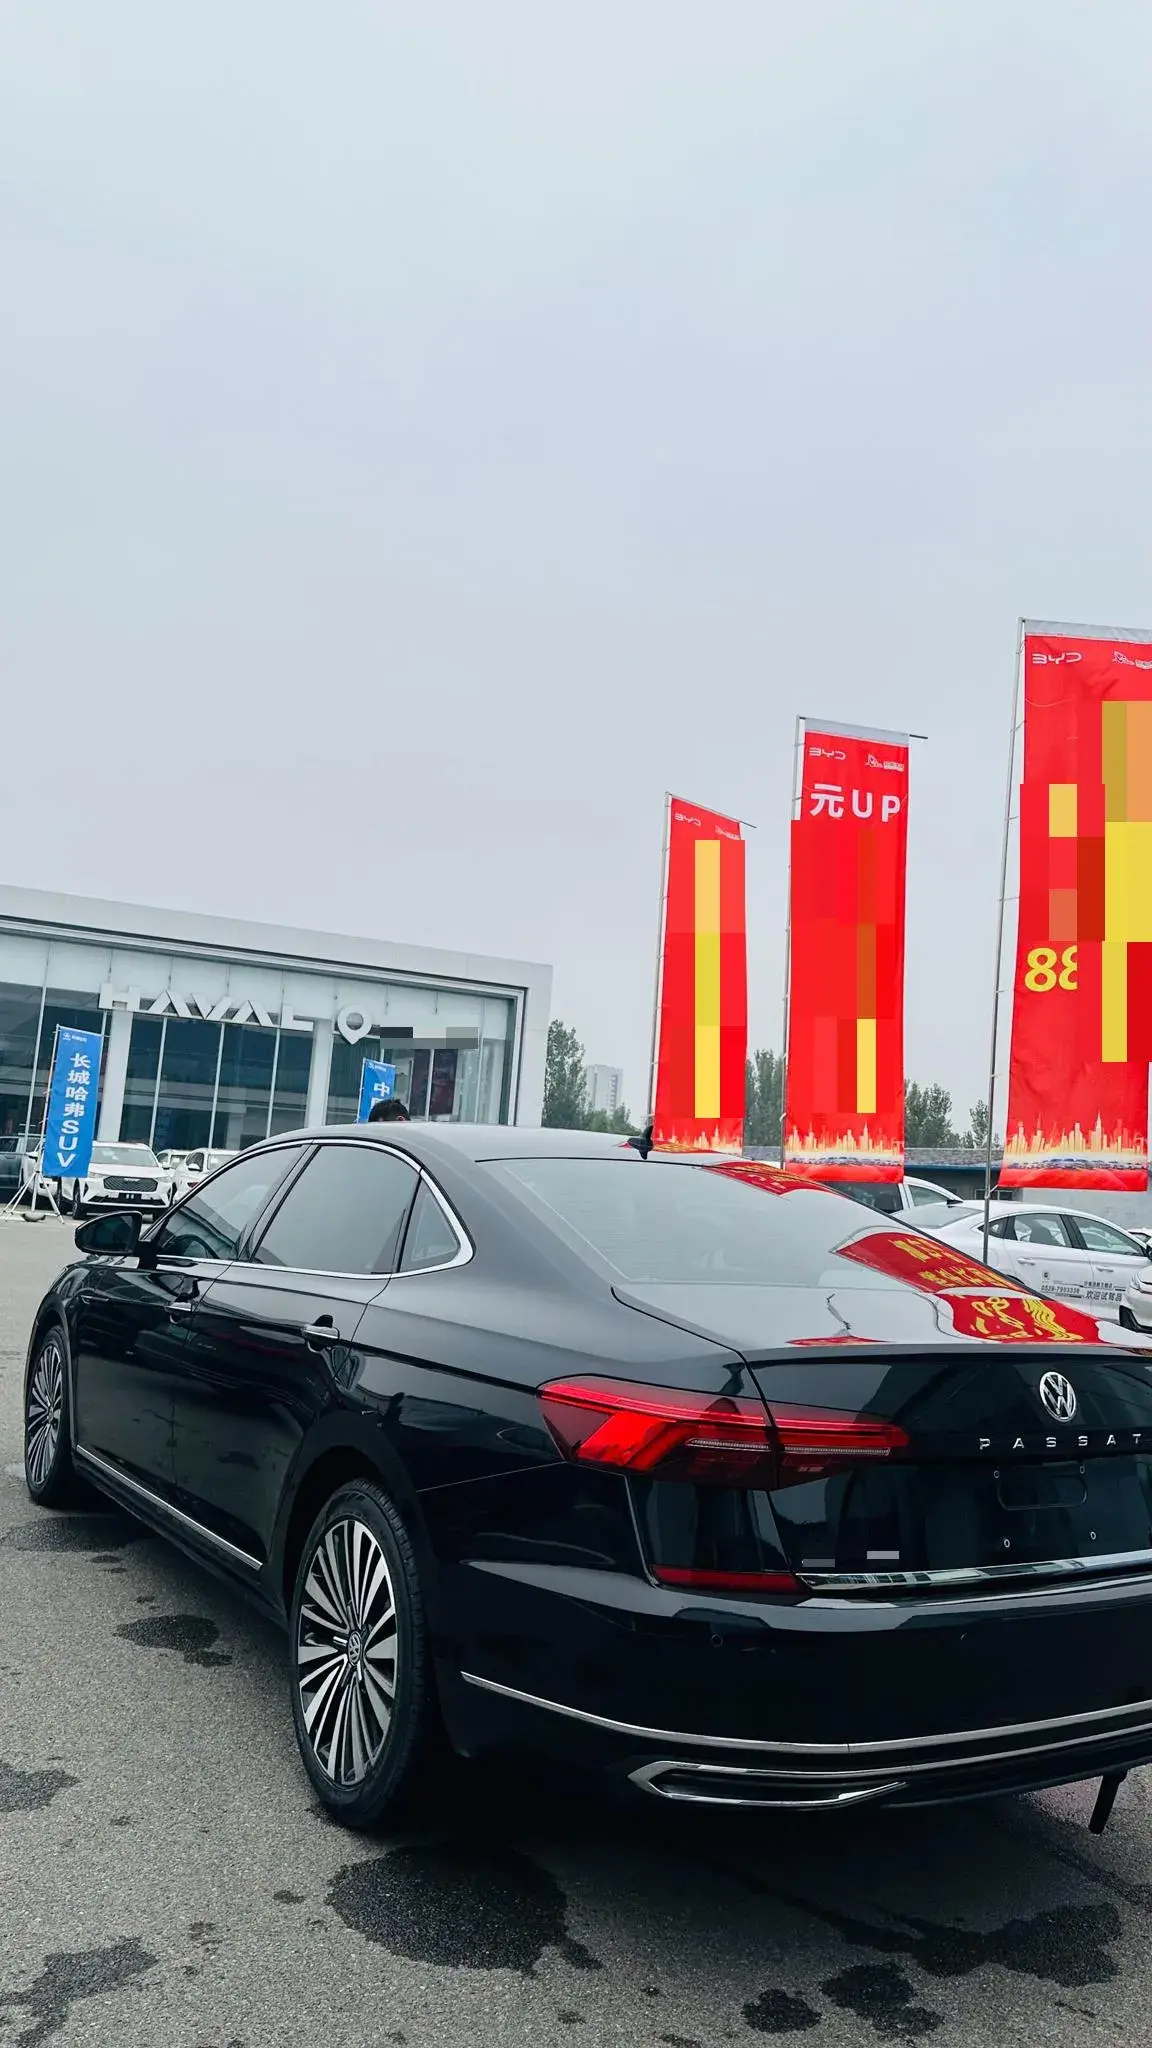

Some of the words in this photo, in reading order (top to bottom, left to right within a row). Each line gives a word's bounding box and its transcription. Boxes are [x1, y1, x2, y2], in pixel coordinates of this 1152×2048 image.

[1032, 652, 1082, 665] BYD
[809, 747, 846, 761] BYD
[98, 982, 314, 1032] HAVAL
[57, 1052, 92, 1168] 长城哈弗SUV
[979, 1433, 1142, 1450] PASSAT
